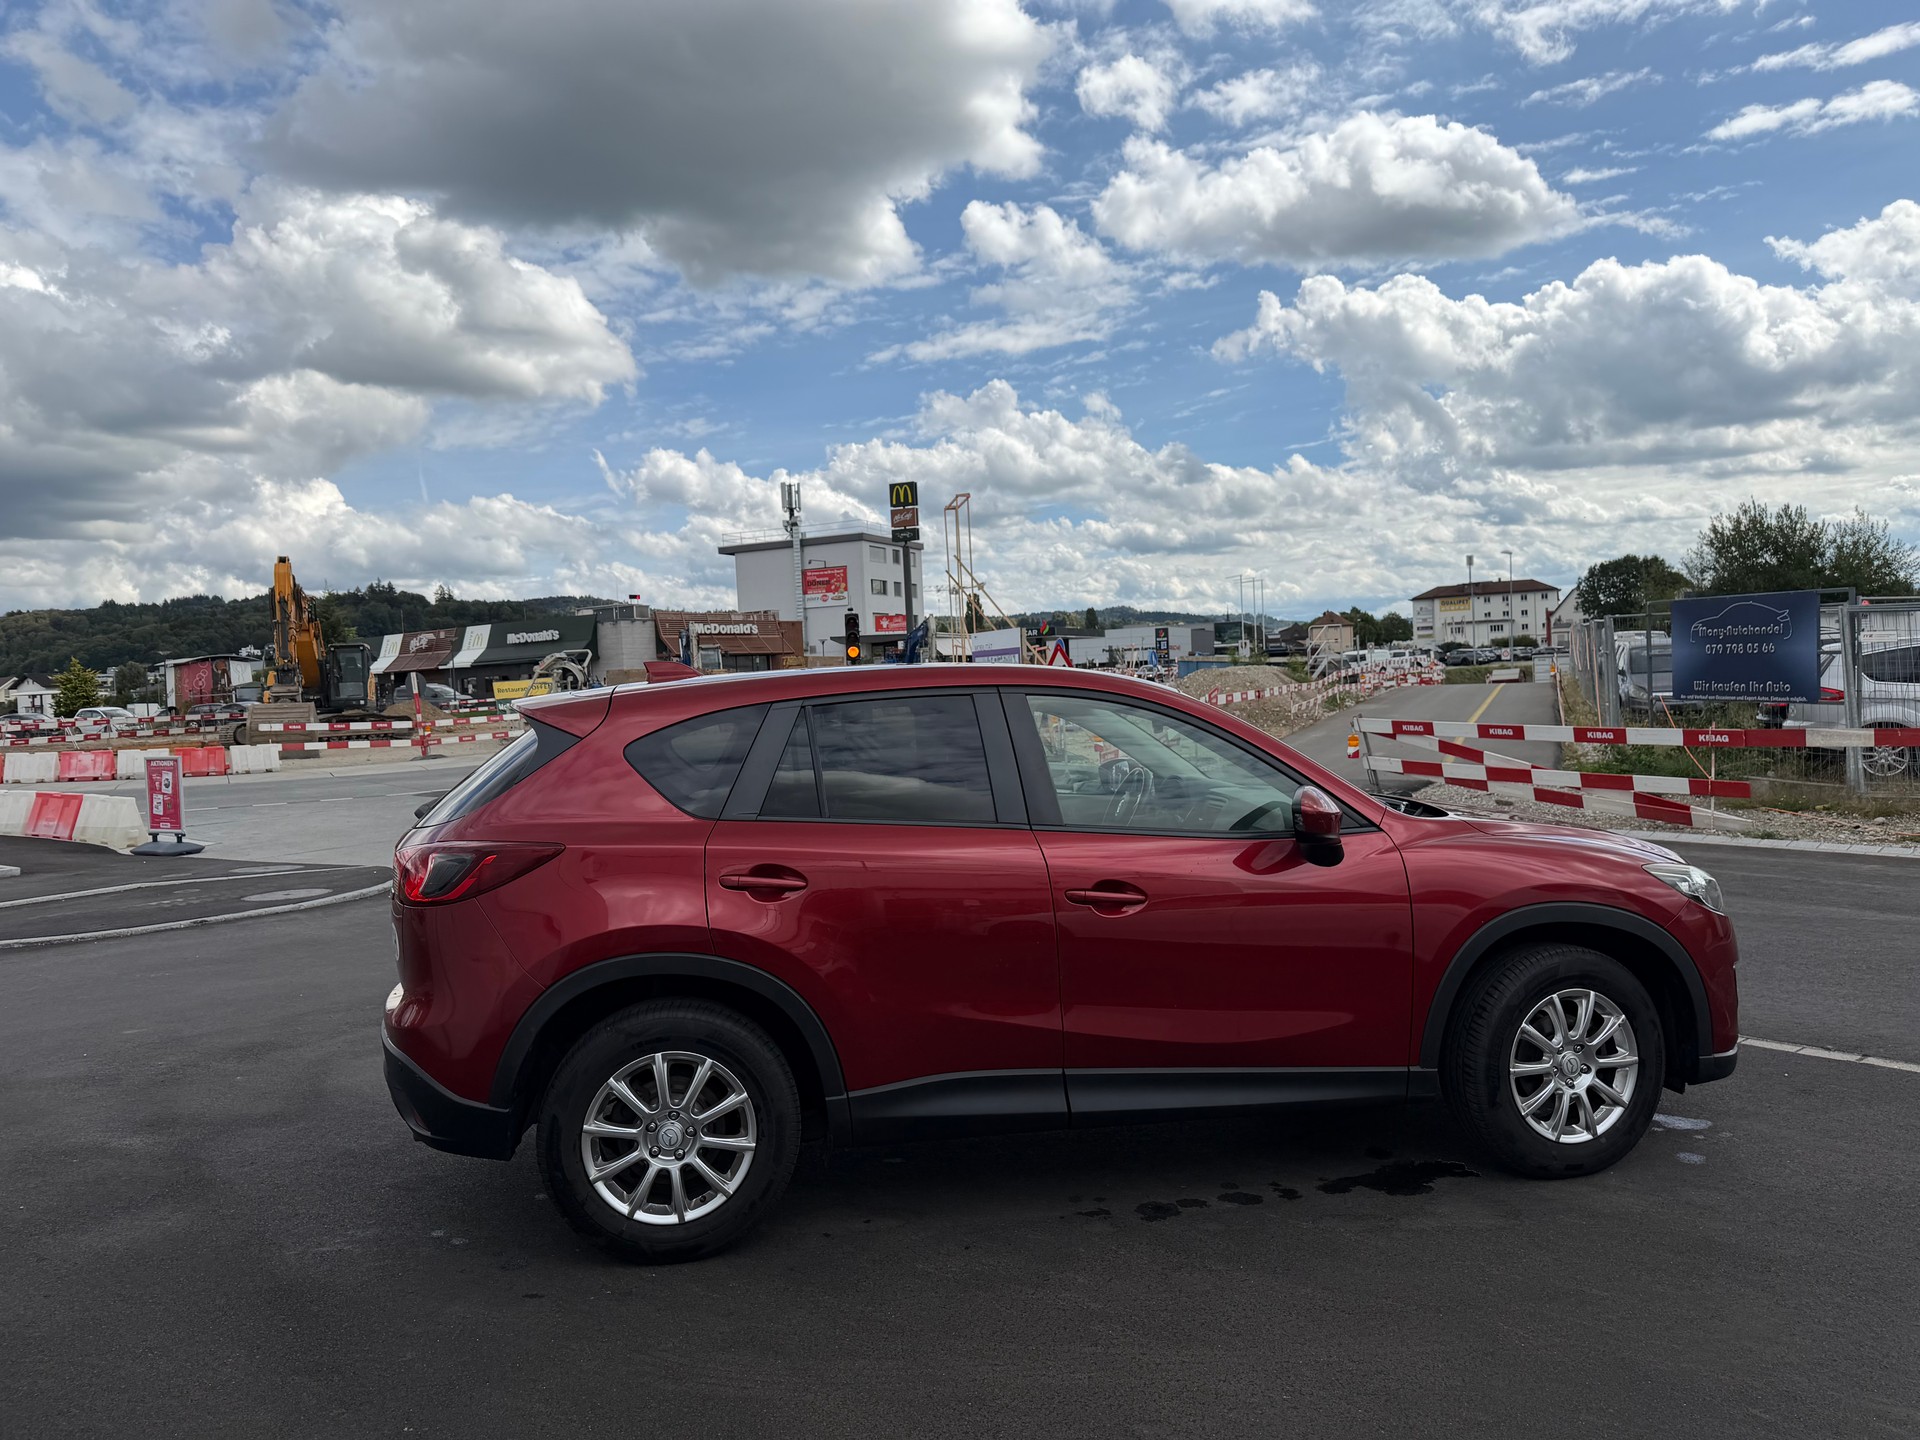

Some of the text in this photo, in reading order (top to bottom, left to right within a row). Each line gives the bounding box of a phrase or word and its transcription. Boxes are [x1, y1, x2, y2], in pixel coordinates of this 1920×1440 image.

[697, 623, 759, 634] McDonald's
[507, 629, 560, 644] McDonald's
[1705, 642, 1775, 654] 079 798 05 66
[1693, 680, 1791, 693] Wir kaufen Ihr Auto
[1402, 724, 1424, 732] KIBAG
[1489, 728, 1514, 736] KIBAG
[1586, 731, 1614, 739] KIBAG
[1698, 734, 1729, 743] KIBAG
